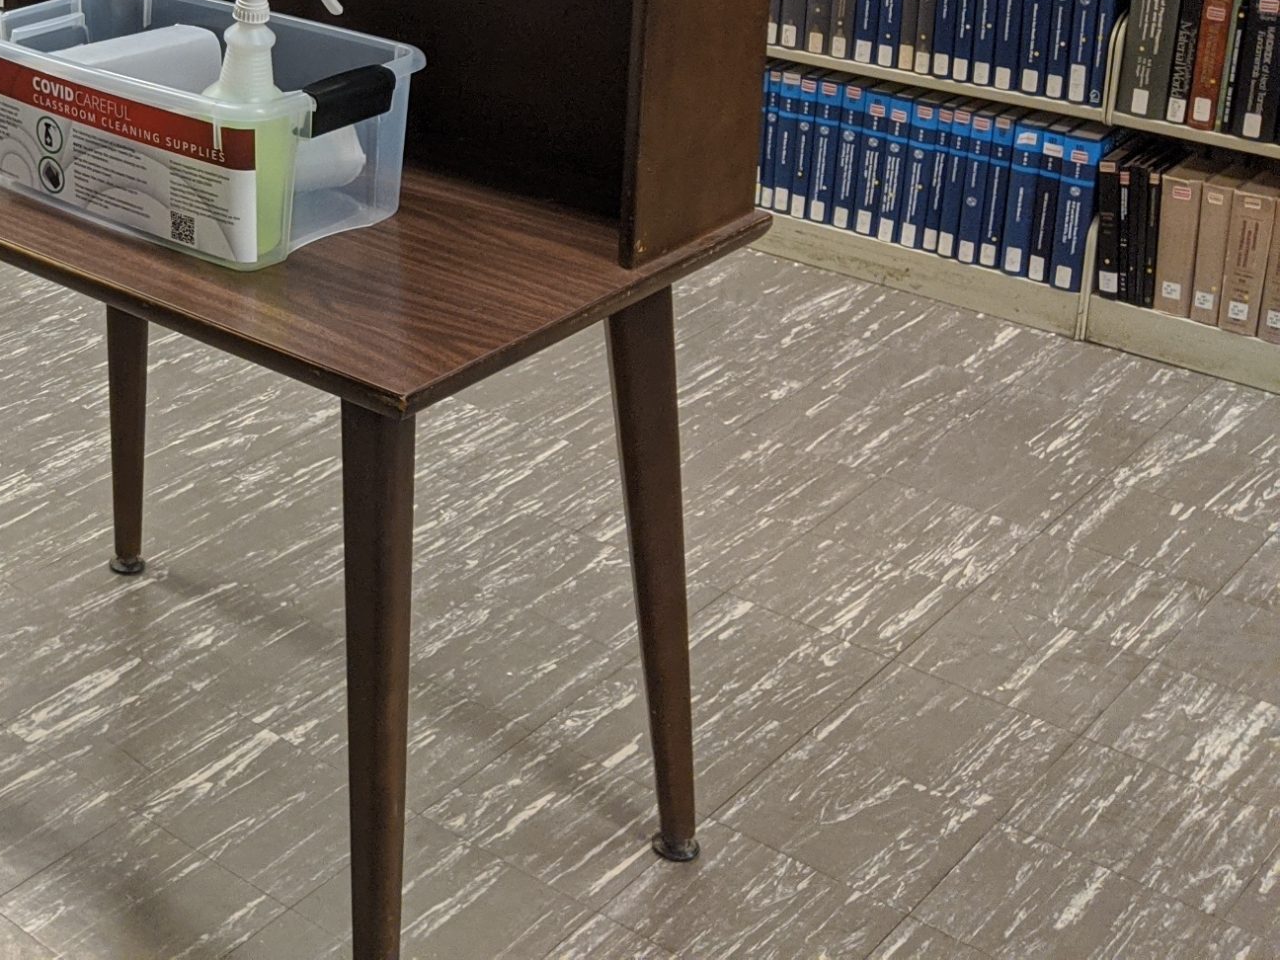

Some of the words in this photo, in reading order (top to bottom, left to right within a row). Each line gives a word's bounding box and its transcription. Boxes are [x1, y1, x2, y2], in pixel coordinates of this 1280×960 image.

[1175, 19, 1192, 65] Material
[32, 93, 96, 124] CLASSROOM
[101, 117, 160, 144] CLEANING
[165, 136, 226, 163] SUPPLIES
